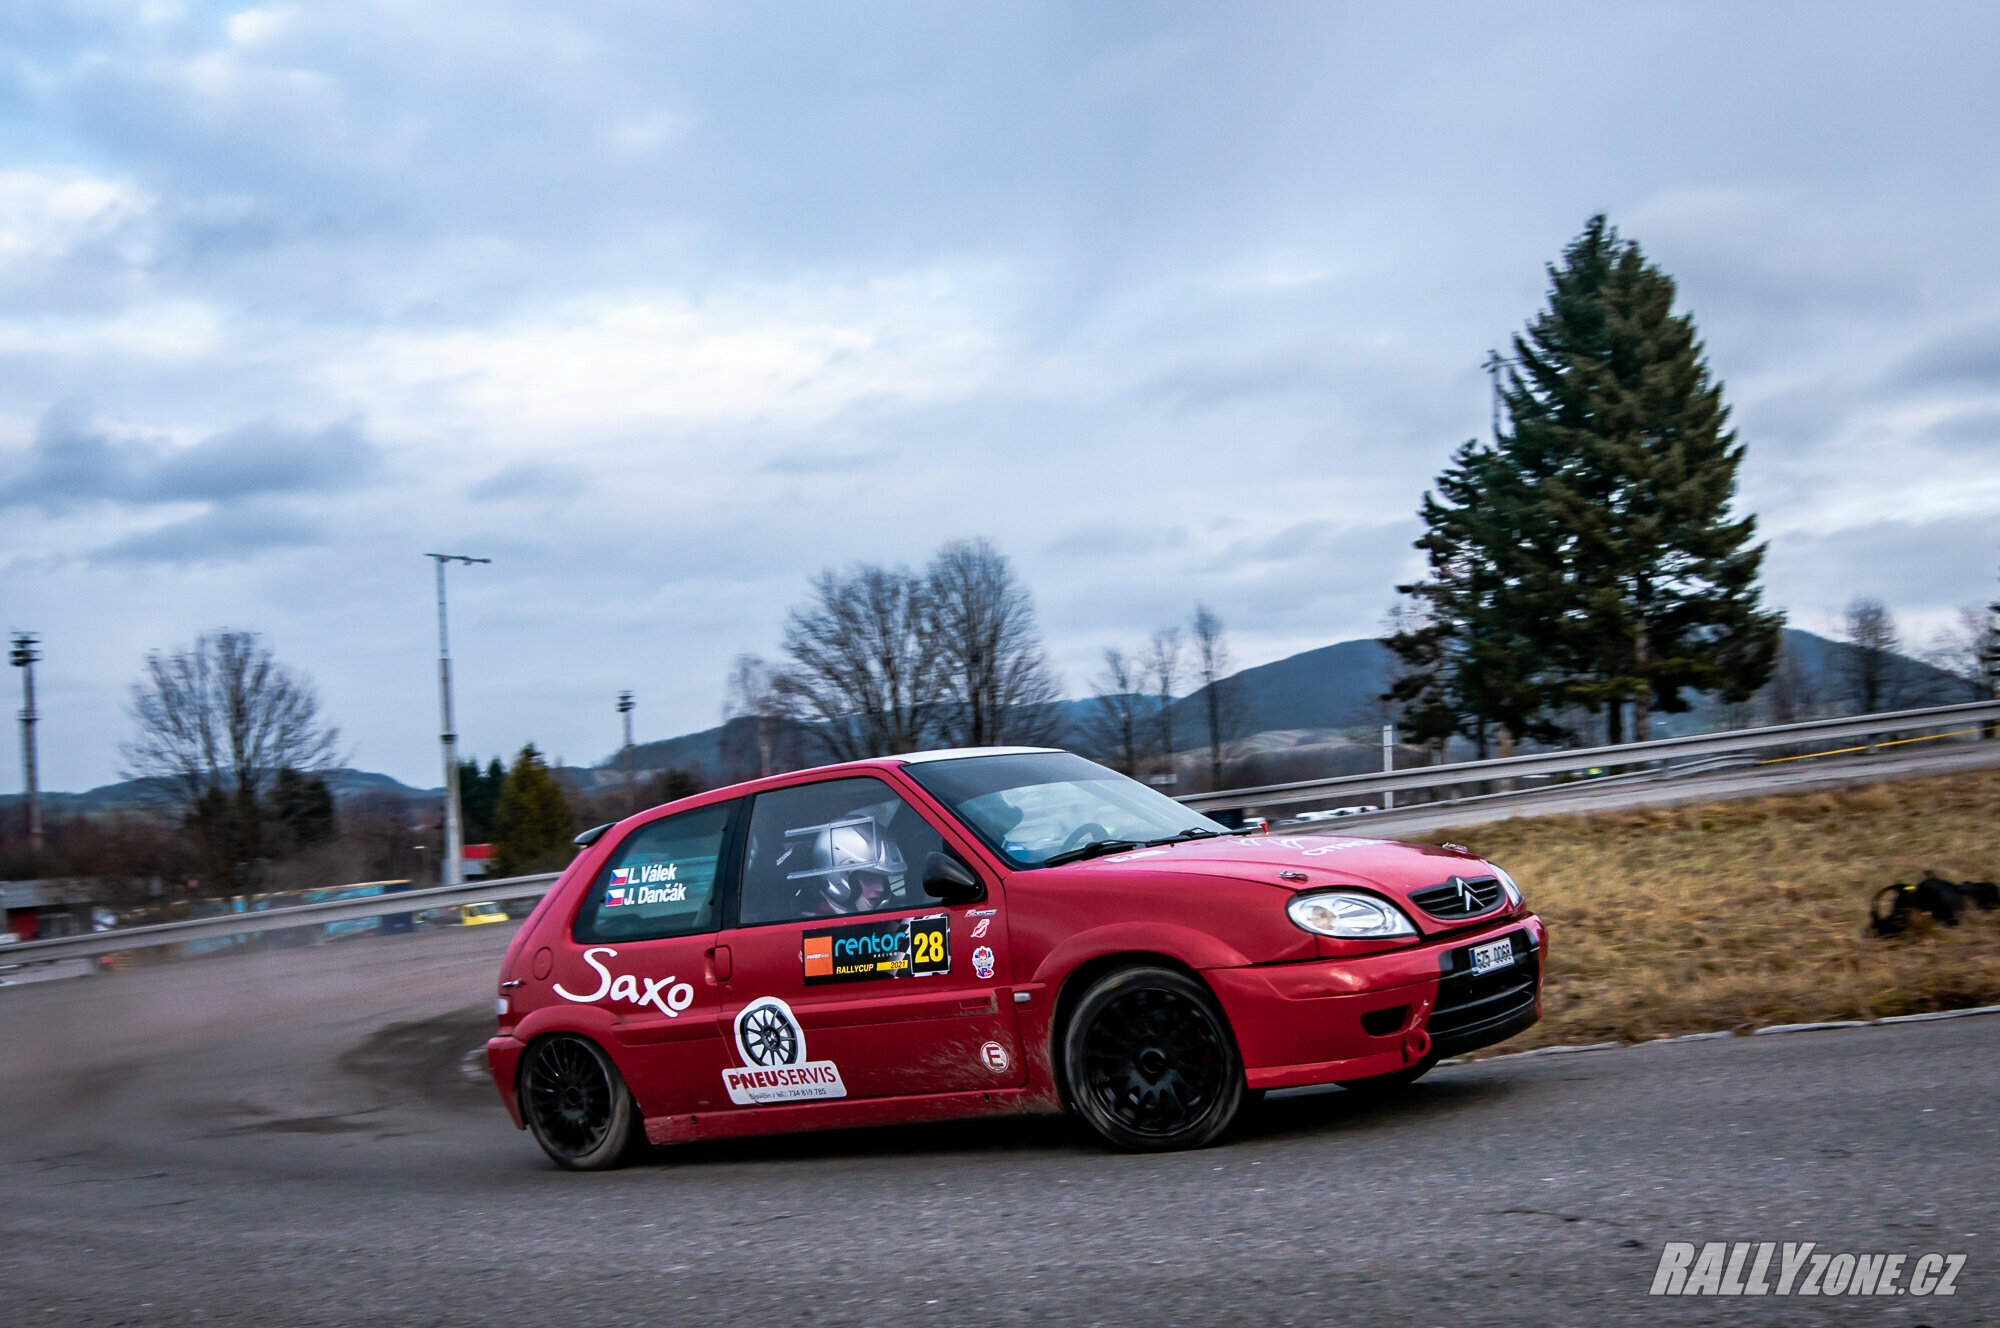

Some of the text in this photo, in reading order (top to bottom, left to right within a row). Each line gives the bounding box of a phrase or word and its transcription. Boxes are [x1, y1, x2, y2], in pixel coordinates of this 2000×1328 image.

[628, 863, 677, 884] L. Válek
[623, 882, 687, 906] J. Dančák
[834, 932, 907, 957] rentor
[913, 931, 944, 964] 28
[835, 961, 906, 975] RALLYCUP 2021
[552, 947, 694, 1018] Saxo
[985, 1046, 1004, 1067] E
[727, 1066, 837, 1091] PNEUSERVIS
[788, 1089, 800, 1097] 734
